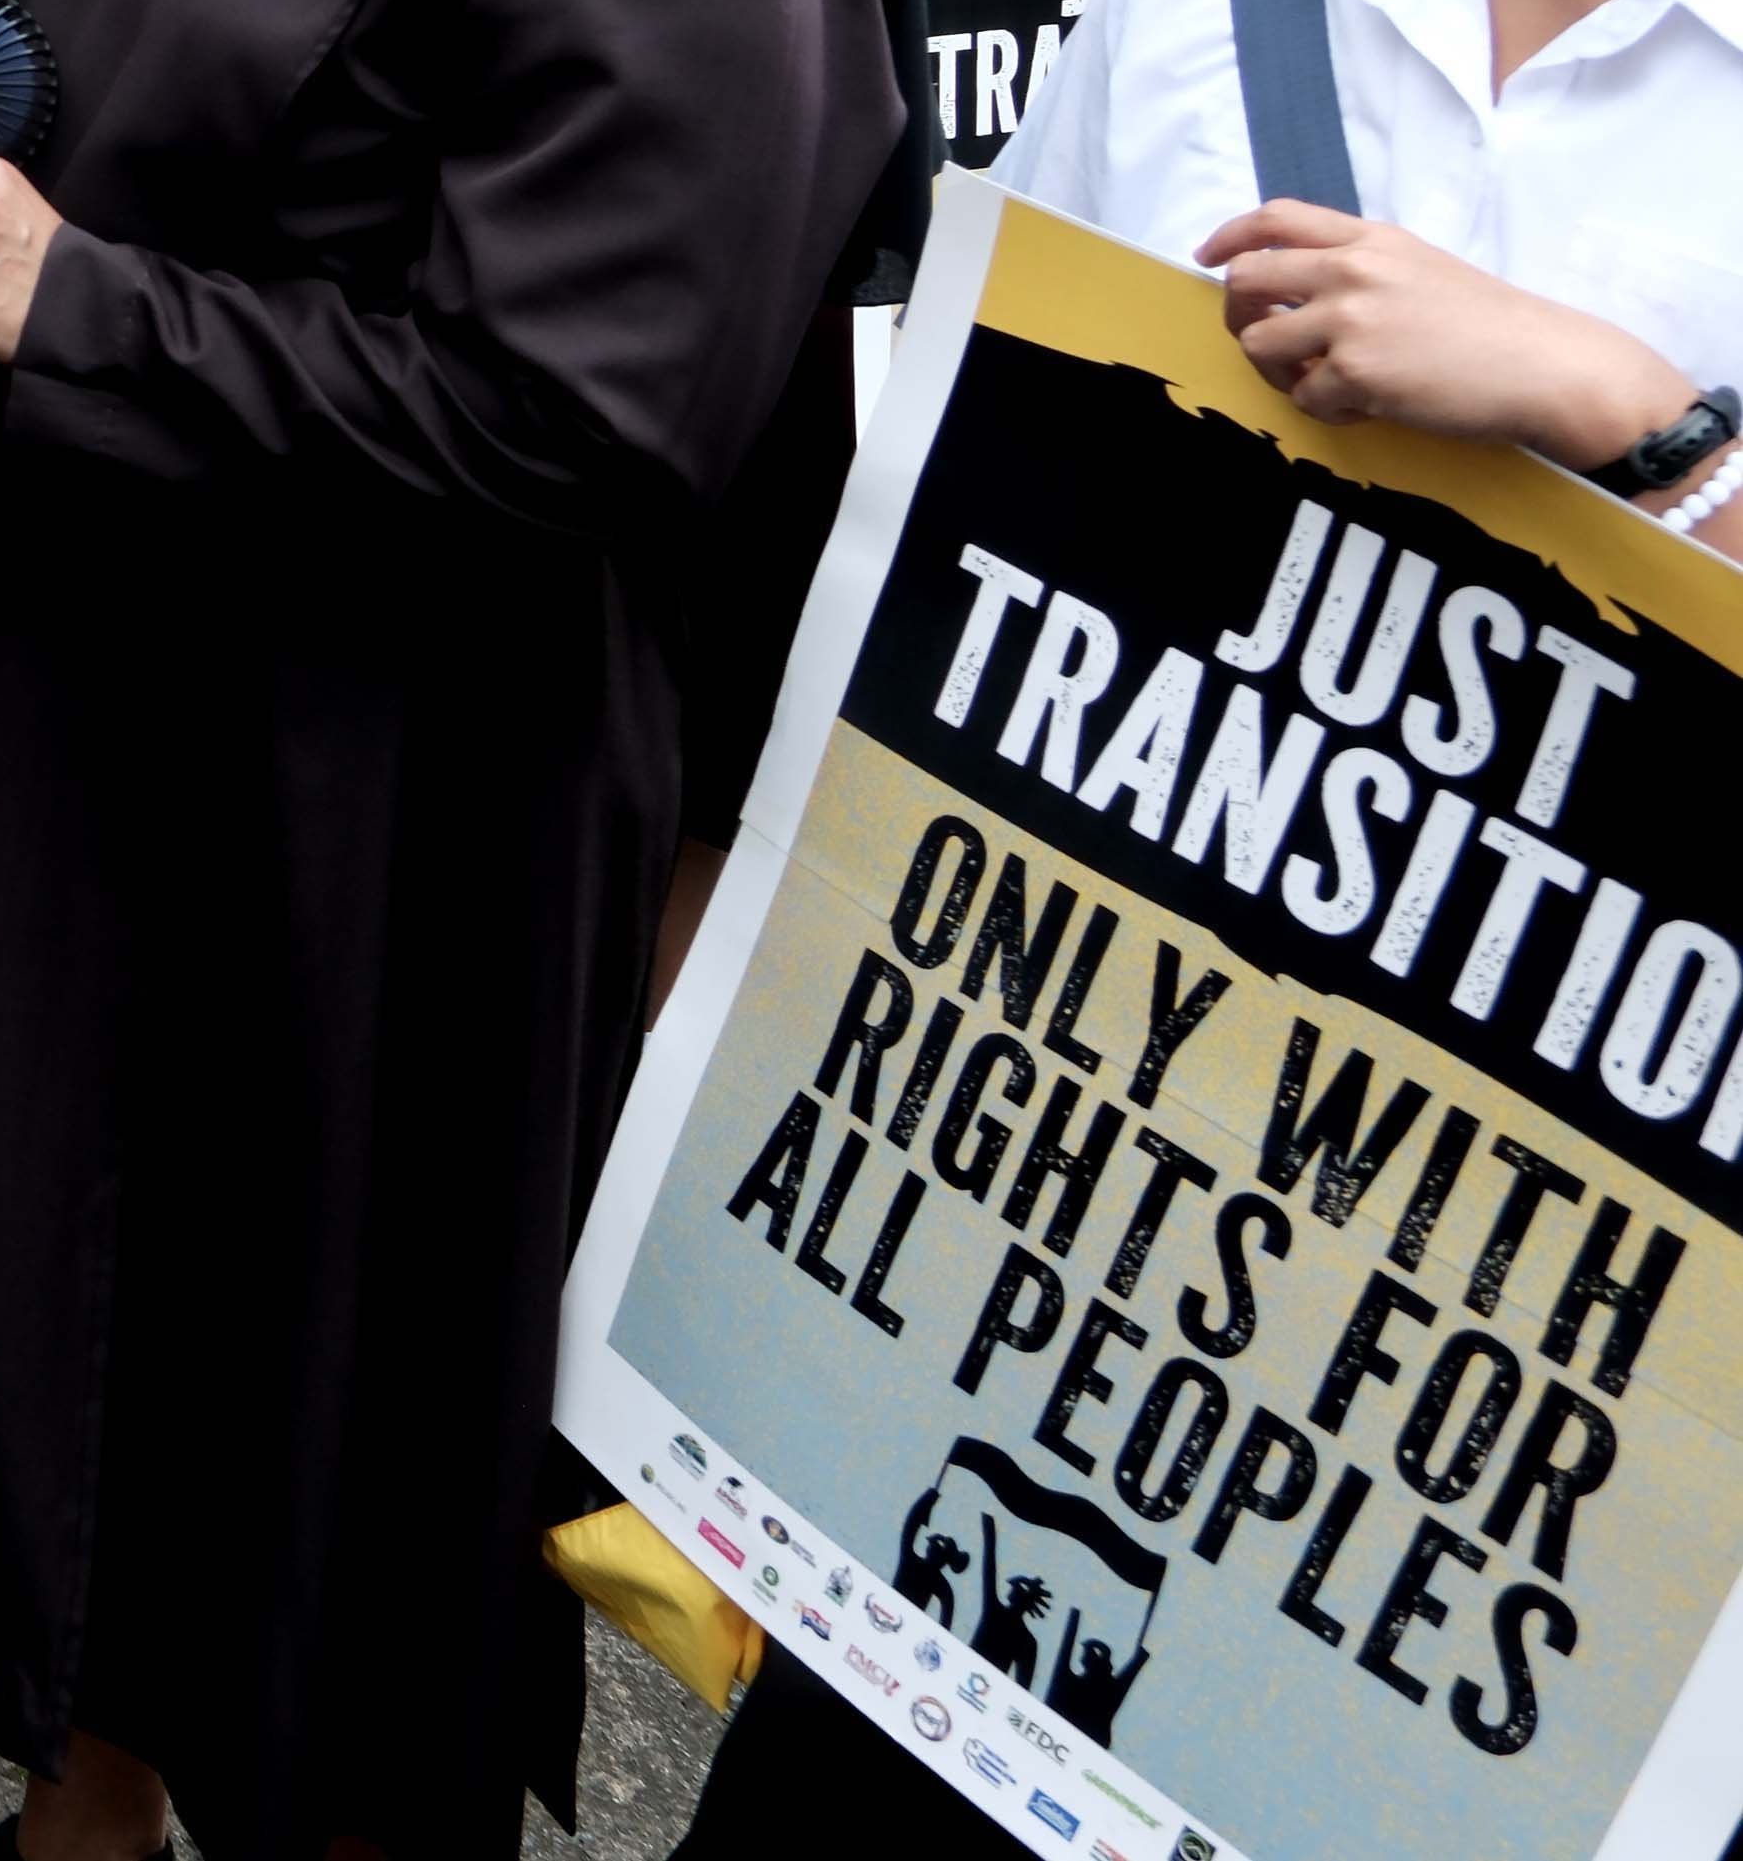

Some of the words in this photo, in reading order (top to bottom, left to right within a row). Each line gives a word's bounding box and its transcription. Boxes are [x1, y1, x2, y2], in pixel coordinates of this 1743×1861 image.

[932, 542, 1743, 1162] TRANSITIO
[1213, 496, 1636, 830] JUST
[814, 946, 1294, 1360] RIGHTS
[1308, 1272, 1619, 1582] FOR
[889, 814, 1234, 1109] ONLY
[1261, 1016, 1688, 1401] WITH
[725, 1090, 929, 1338] ALL
[951, 1242, 1581, 1758] PEOPLES
[1025, 1720, 1071, 1763] FDC
